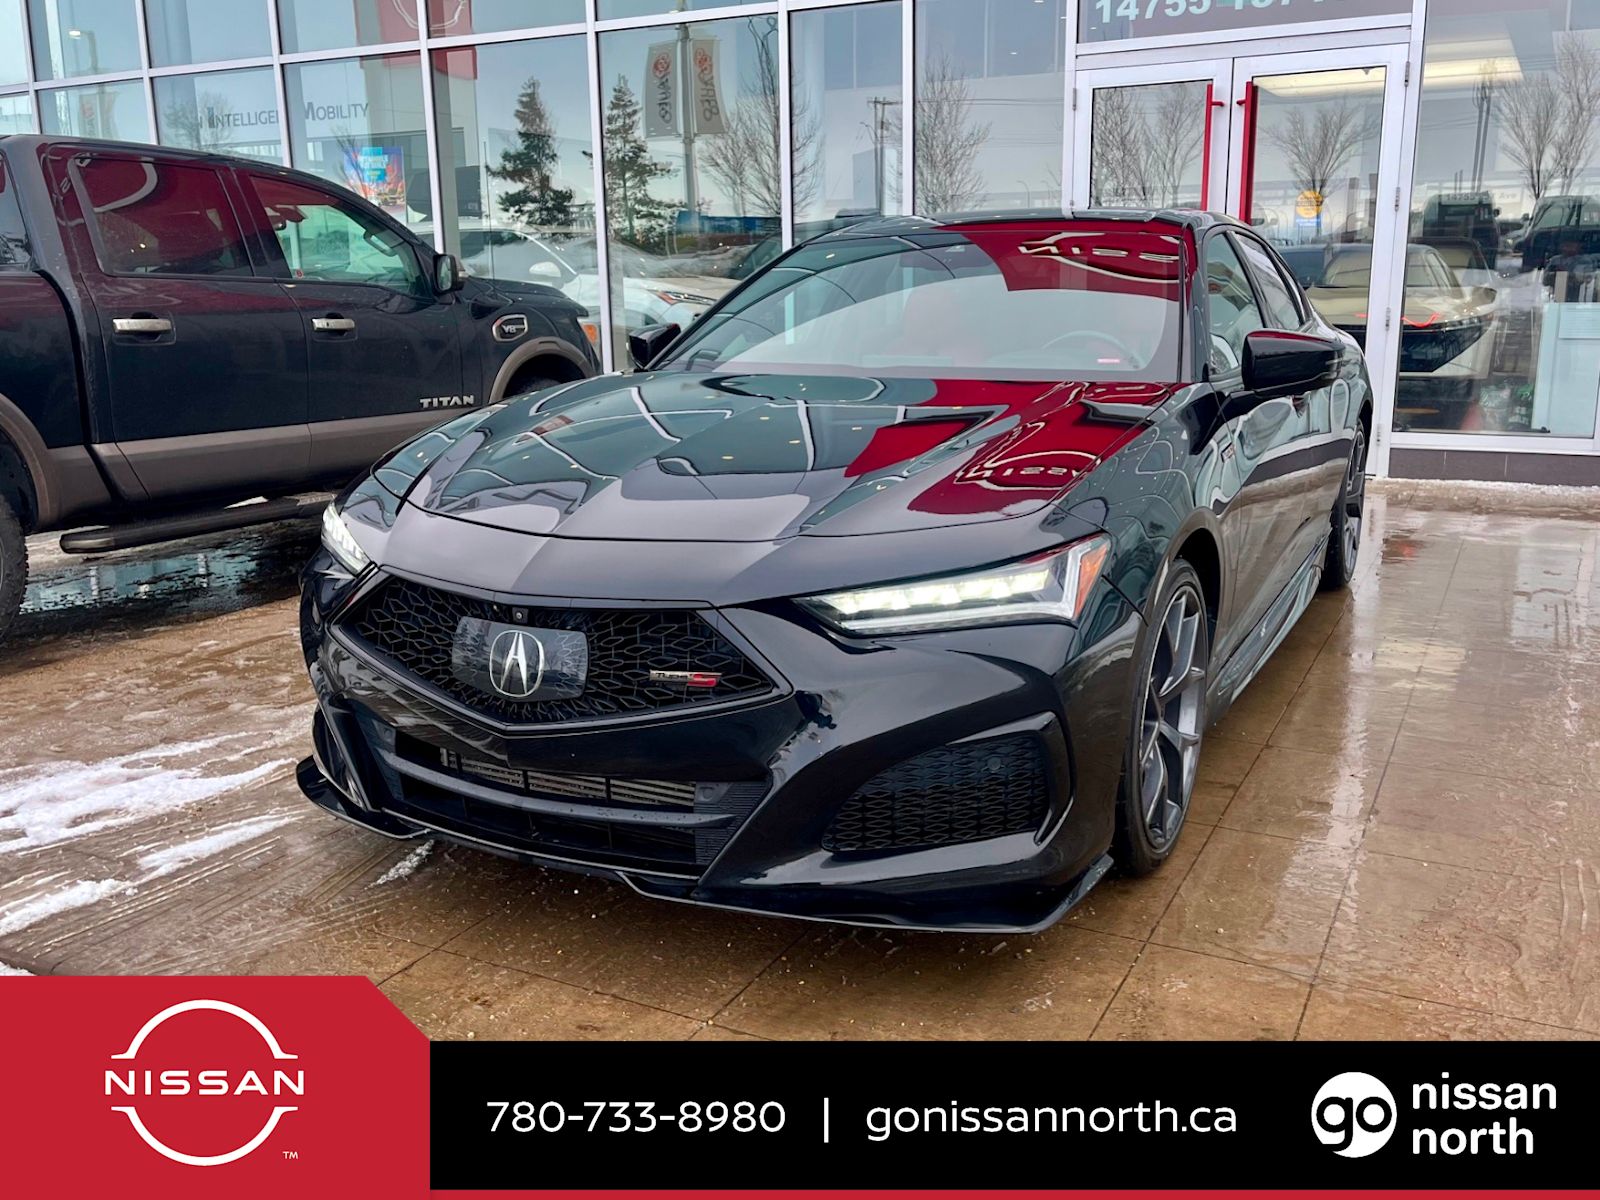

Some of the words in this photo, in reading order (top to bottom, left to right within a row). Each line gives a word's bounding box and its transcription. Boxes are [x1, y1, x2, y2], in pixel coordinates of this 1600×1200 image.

[1095, 0, 1211, 23] 14755
[207, 106, 279, 129] INTELLIGE
[502, 325, 516, 333] V8
[420, 395, 474, 408] TITAN
